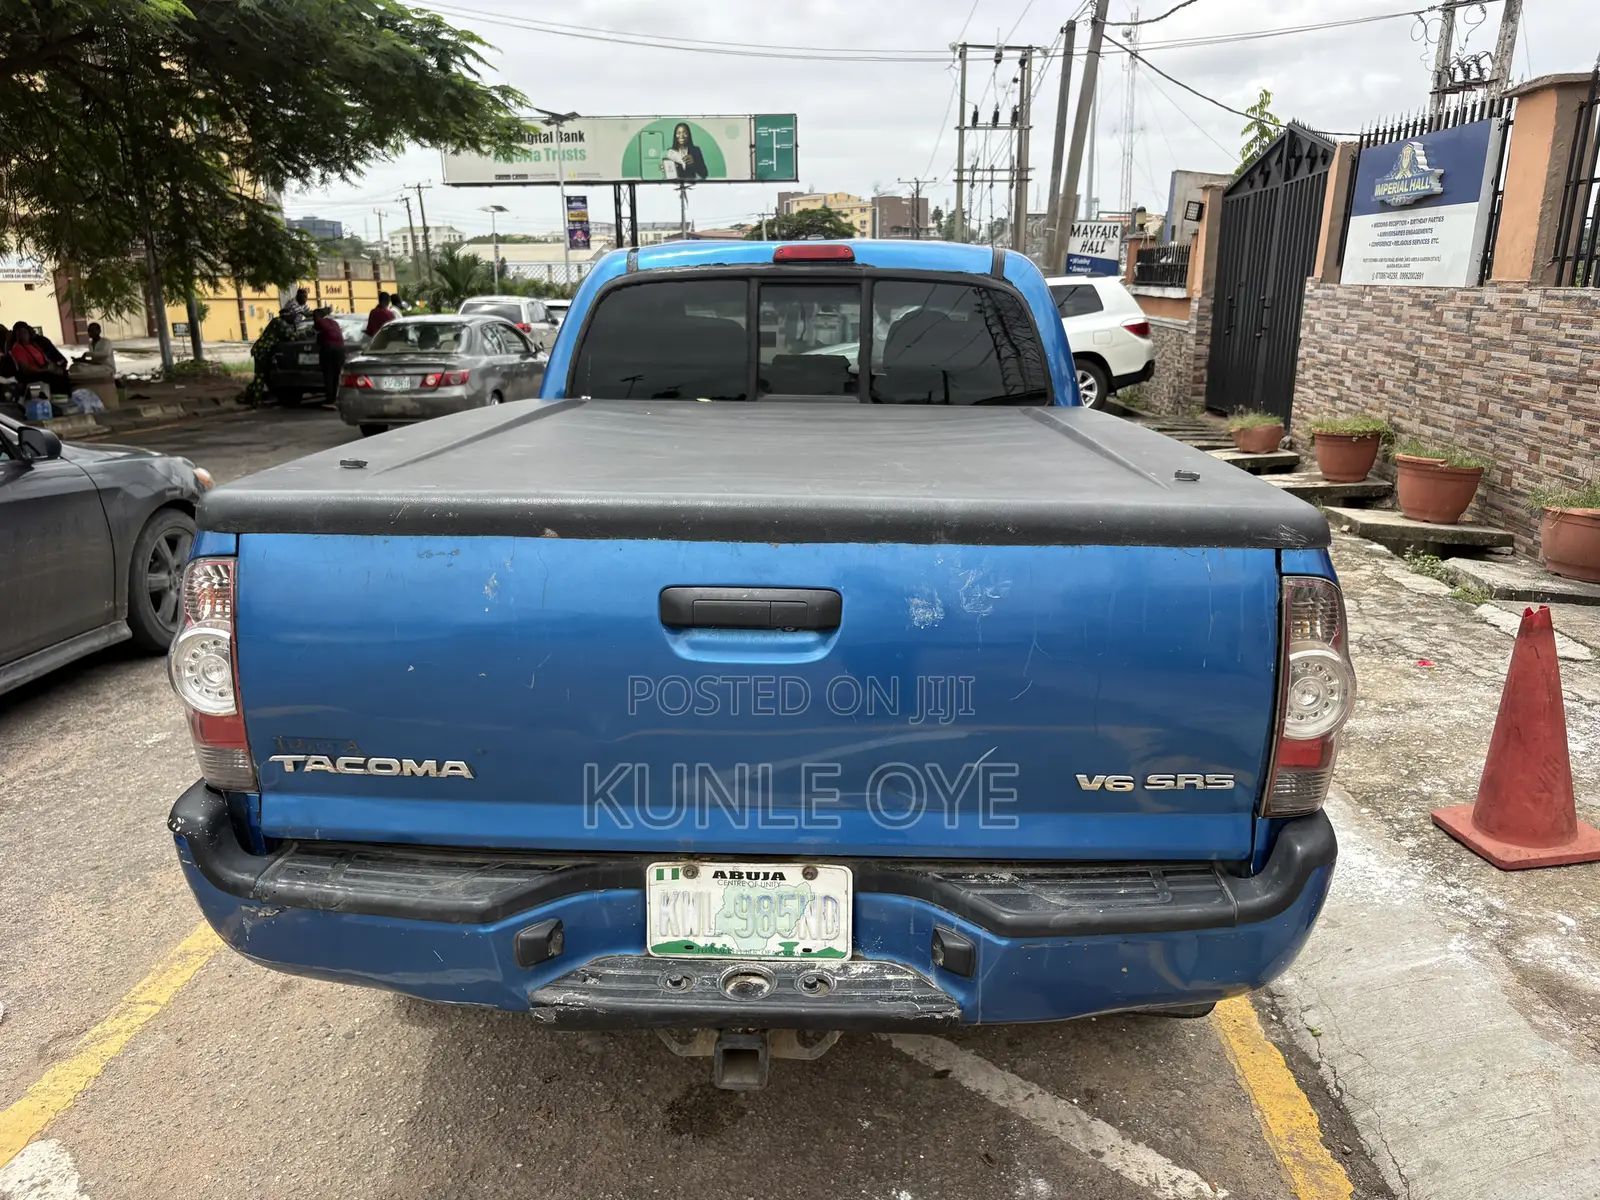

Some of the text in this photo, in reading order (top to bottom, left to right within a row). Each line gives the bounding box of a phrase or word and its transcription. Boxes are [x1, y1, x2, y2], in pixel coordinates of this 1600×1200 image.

[518, 130, 585, 145] igital Bank
[544, 147, 586, 162] Trusts
[1374, 176, 1430, 196] IMPERIAL HALL
[1070, 224, 1119, 239] MAYFAIR
[1080, 240, 1106, 254] HALL
[268, 754, 475, 779] TACOMA
[1075, 773, 1235, 792] V6 SR5
[712, 870, 787, 881] ABUJA
[717, 879, 746, 887] CENTRE
[747, 880, 758, 888] OF
